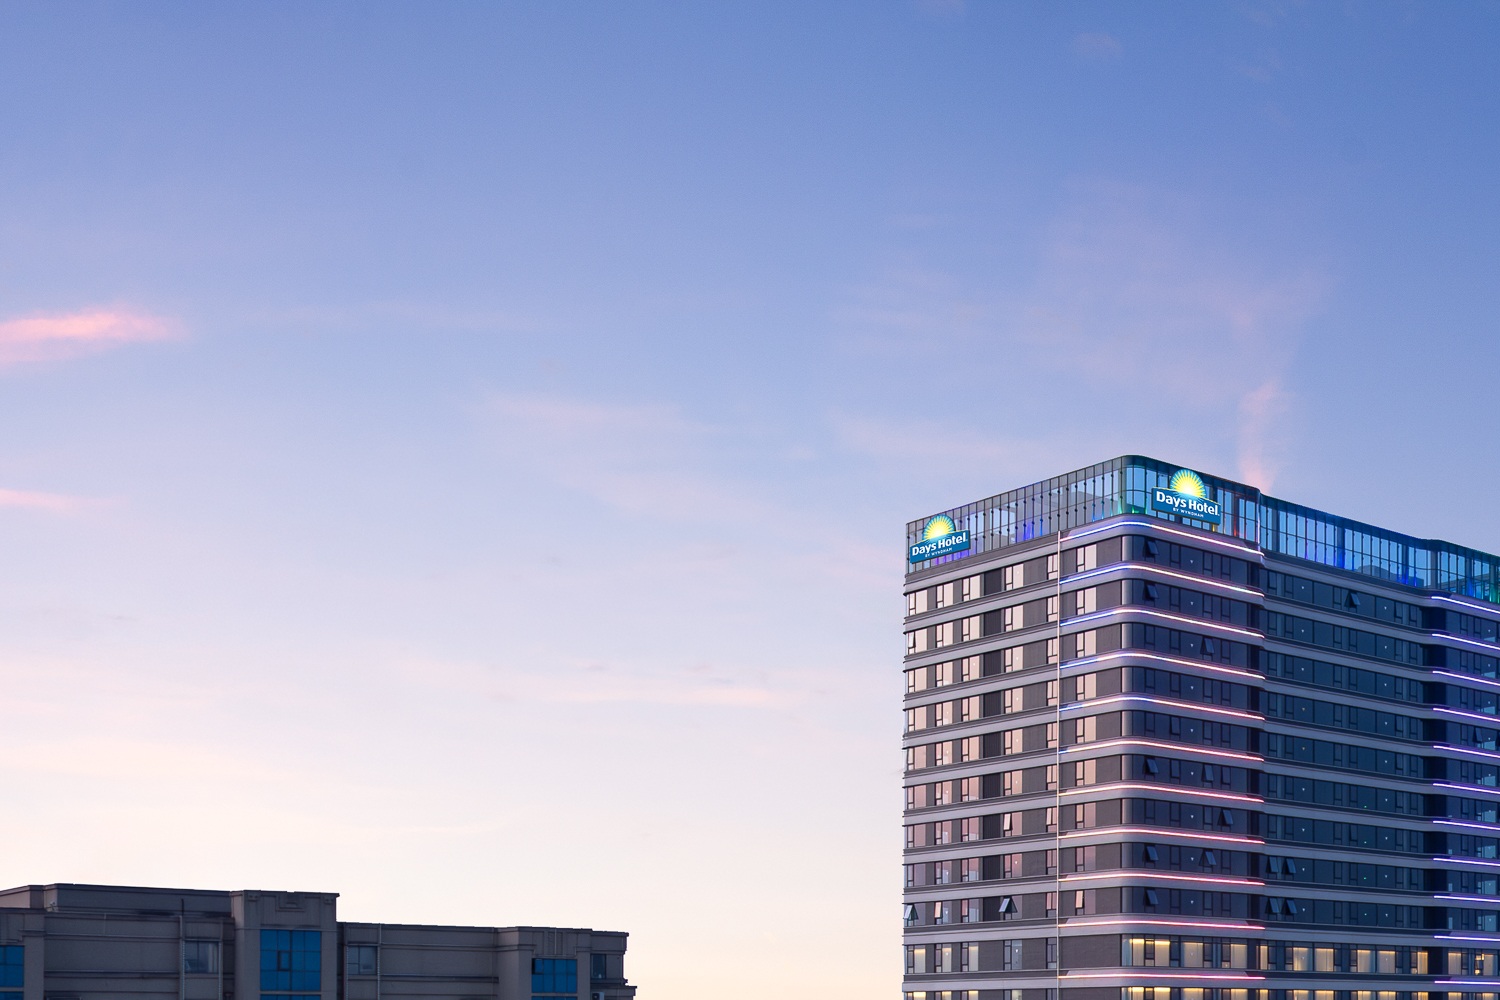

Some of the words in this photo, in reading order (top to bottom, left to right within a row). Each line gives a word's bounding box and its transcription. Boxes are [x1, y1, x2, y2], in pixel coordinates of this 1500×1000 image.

[1156, 491, 1187, 508] Days
[1188, 499, 1218, 516] Hotel
[1180, 509, 1204, 518] WYNDHAM
[912, 542, 937, 556] Days
[937, 532, 966, 549] Hotel
